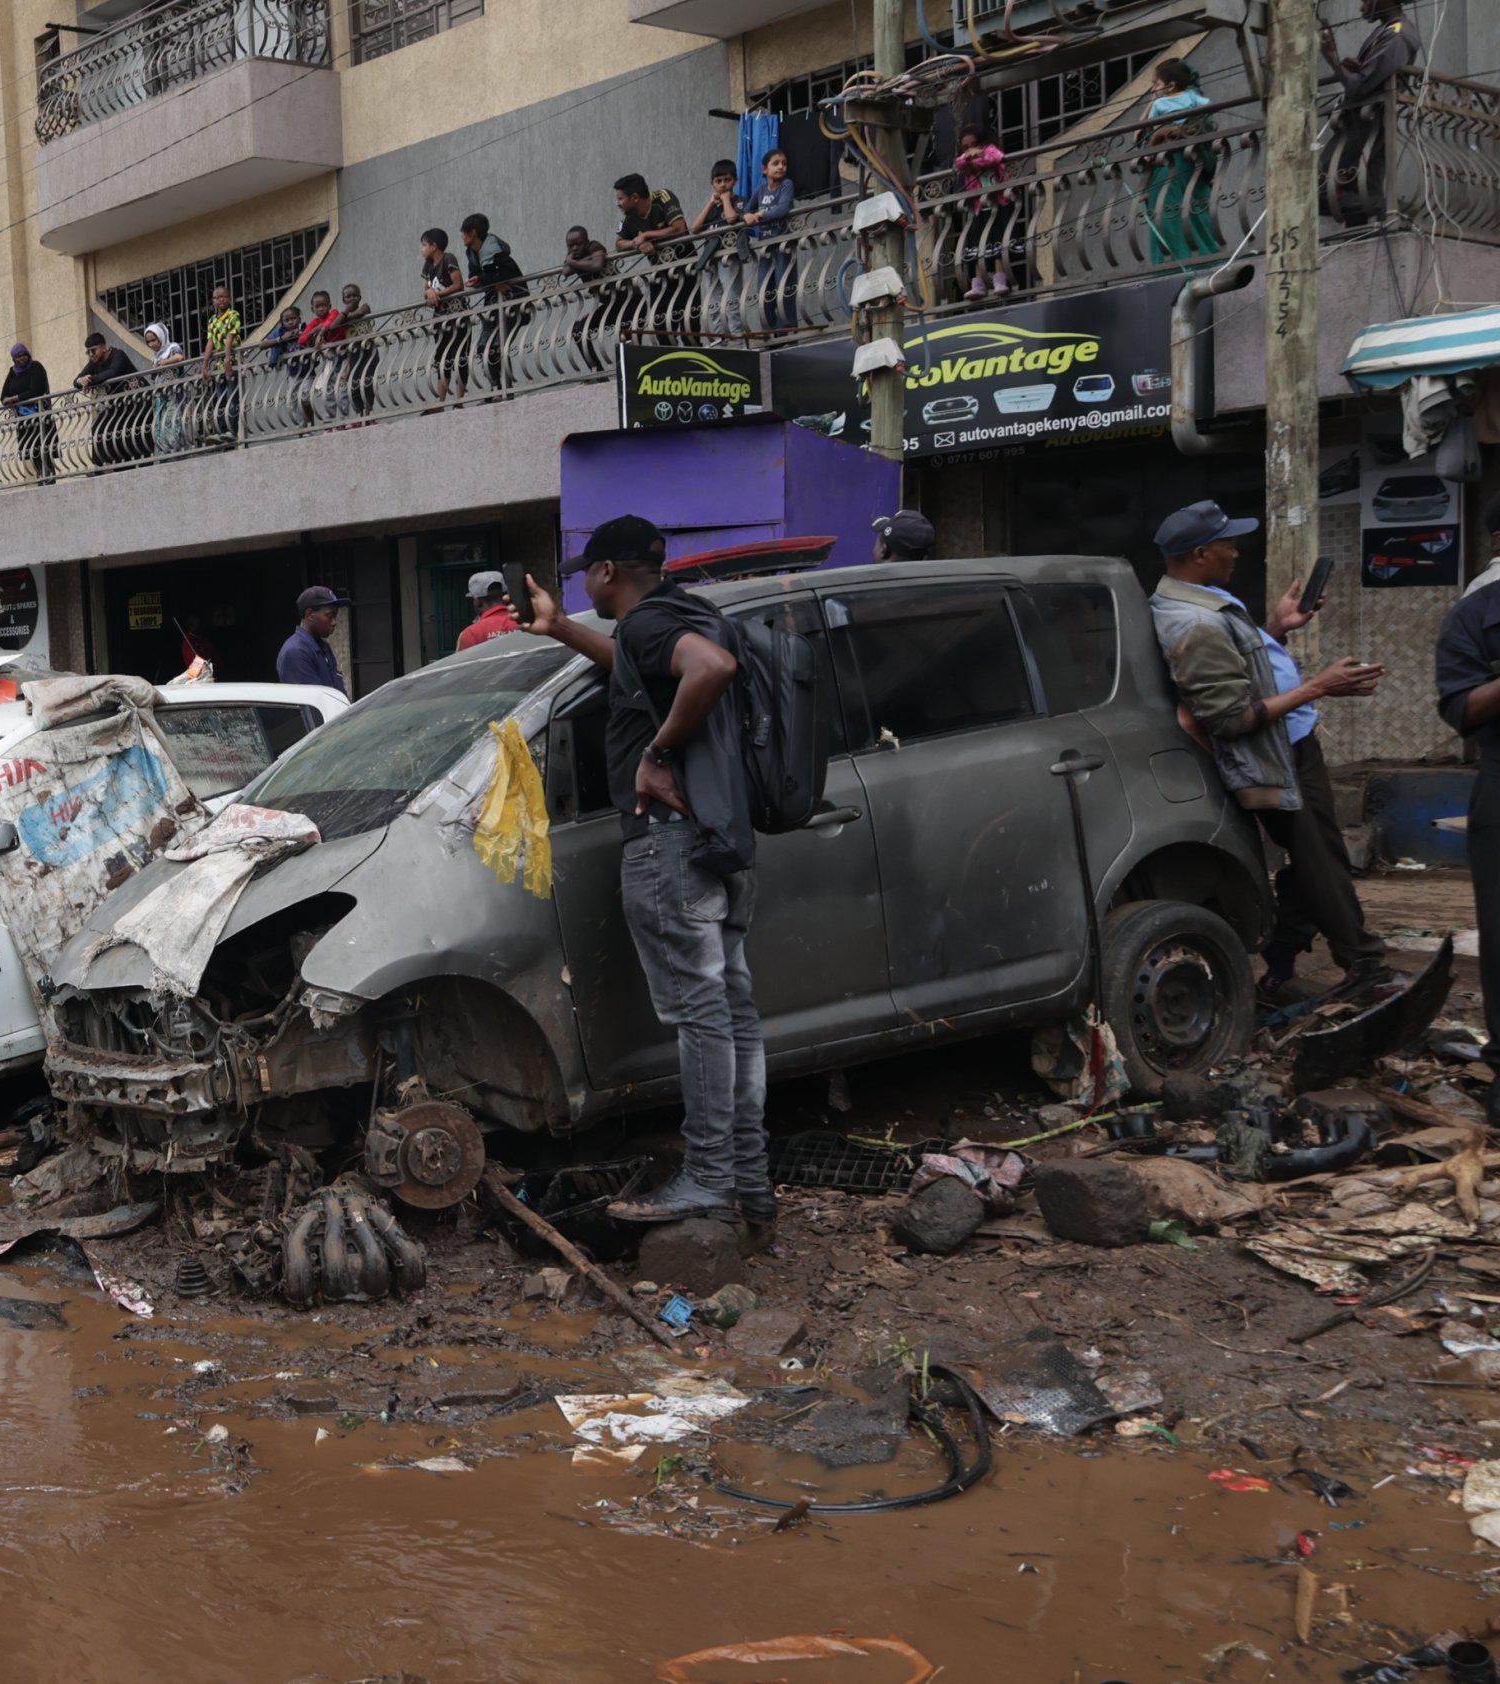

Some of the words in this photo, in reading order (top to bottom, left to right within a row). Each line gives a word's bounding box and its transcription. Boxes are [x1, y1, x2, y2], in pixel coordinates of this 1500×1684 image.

[638, 375, 751, 404] AutoVantage
[947, 452, 975, 464] 0717
[979, 449, 1000, 460] 607
[1003, 446, 1025, 457] 995
[16, 601, 36, 611] SPARES
